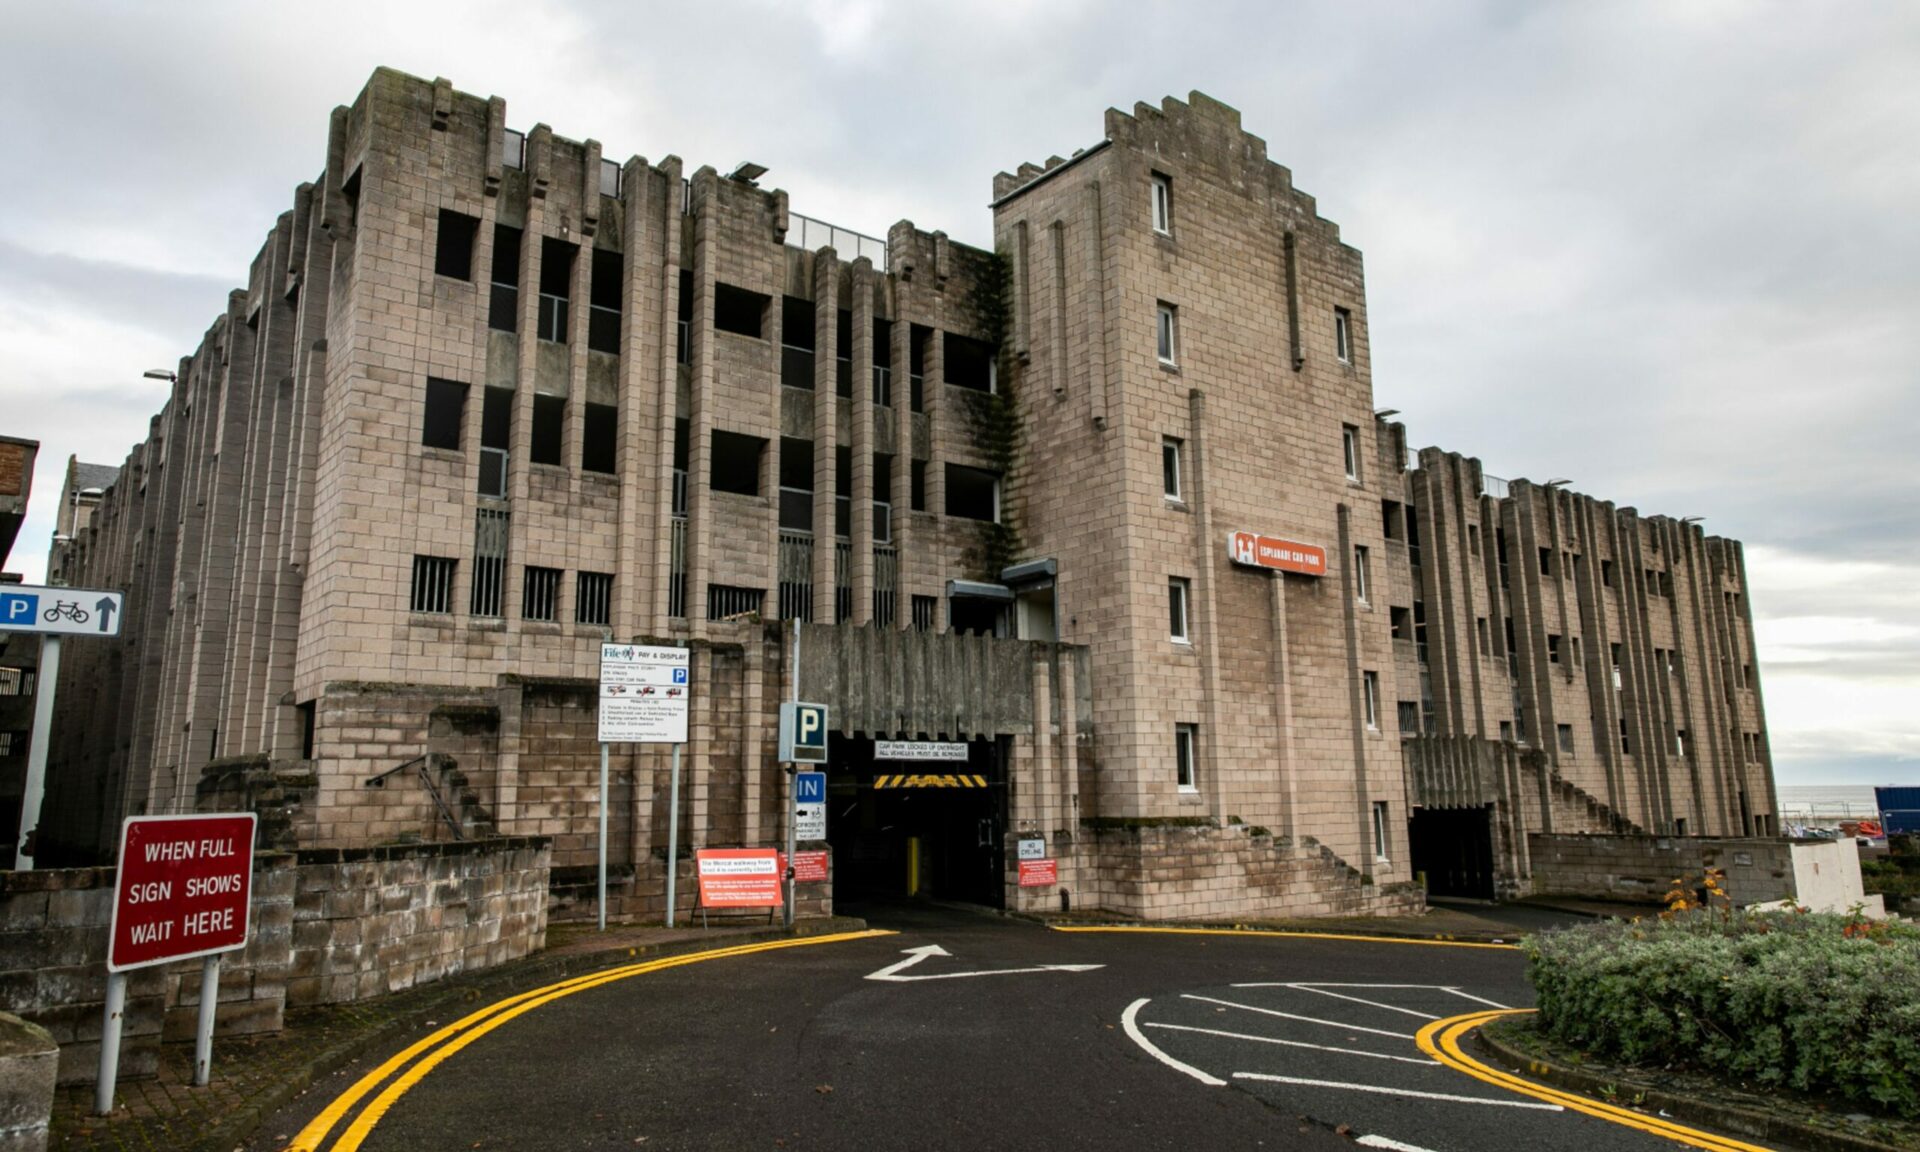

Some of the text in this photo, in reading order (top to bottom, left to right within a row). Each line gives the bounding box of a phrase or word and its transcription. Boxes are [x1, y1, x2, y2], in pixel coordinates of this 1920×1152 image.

[1260, 545, 1320, 566] ESPLANADE CAR PARK
[9, 599, 29, 620] P
[603, 646, 620, 658] Fife
[659, 652, 687, 660] DISPLAY
[676, 670, 684, 682] P
[801, 708, 819, 744] P
[798, 780, 818, 797] IN
[145, 838, 235, 862] WHEN FULL
[128, 874, 241, 904] SIGN SHOWS
[130, 907, 234, 945] WAIT HERE
